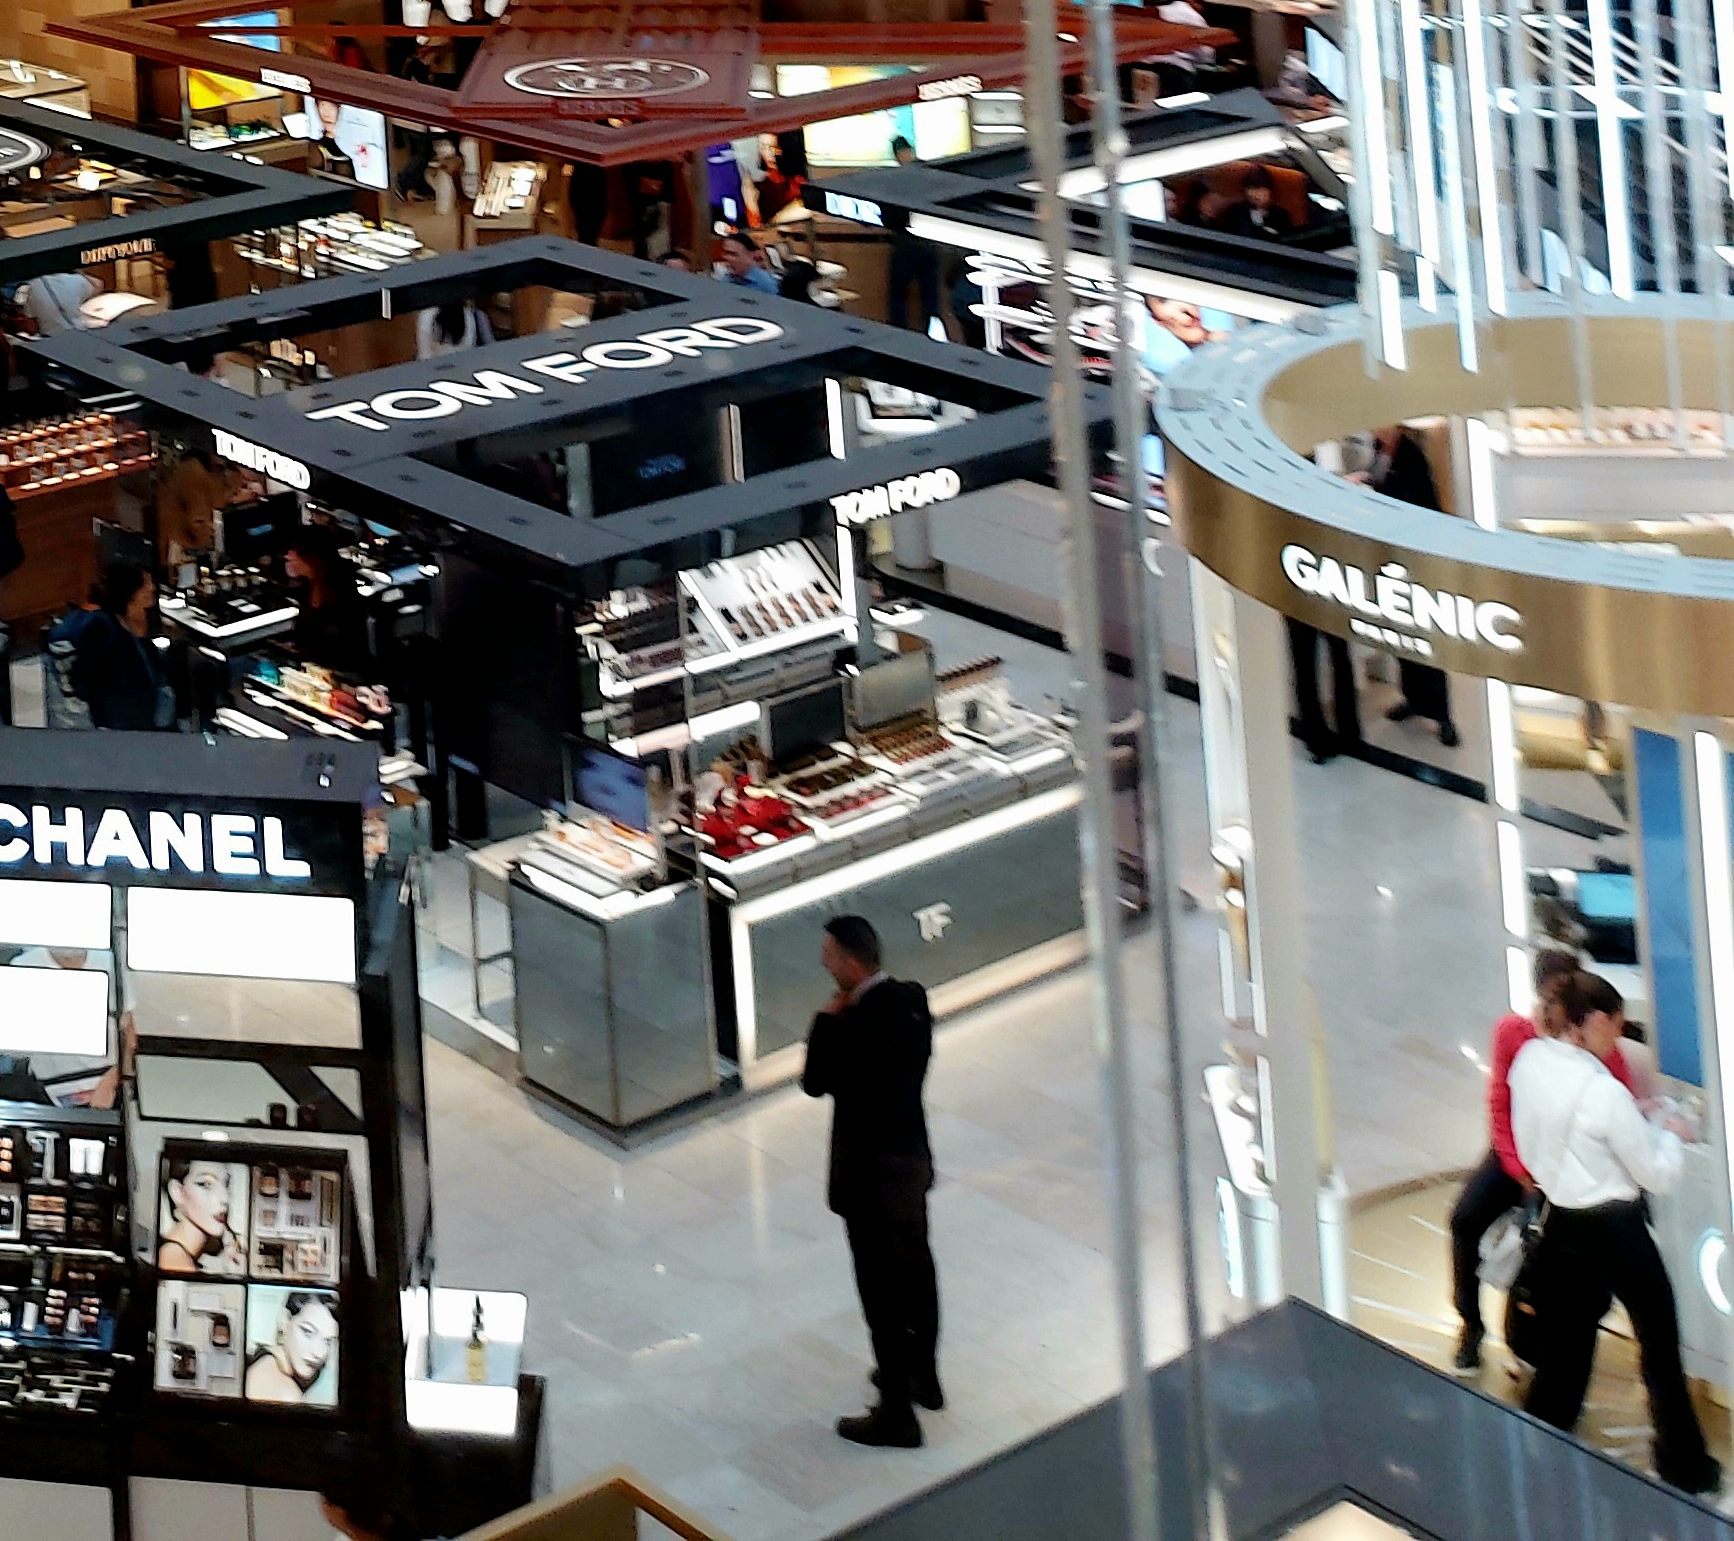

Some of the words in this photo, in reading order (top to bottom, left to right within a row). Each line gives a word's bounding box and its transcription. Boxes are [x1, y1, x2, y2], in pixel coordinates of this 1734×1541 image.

[307, 368, 544, 432] TOM
[520, 315, 785, 385] FORD
[830, 485, 892, 526] TOM
[887, 467, 962, 512] FORD
[1281, 543, 1525, 653] GALÉNIC
